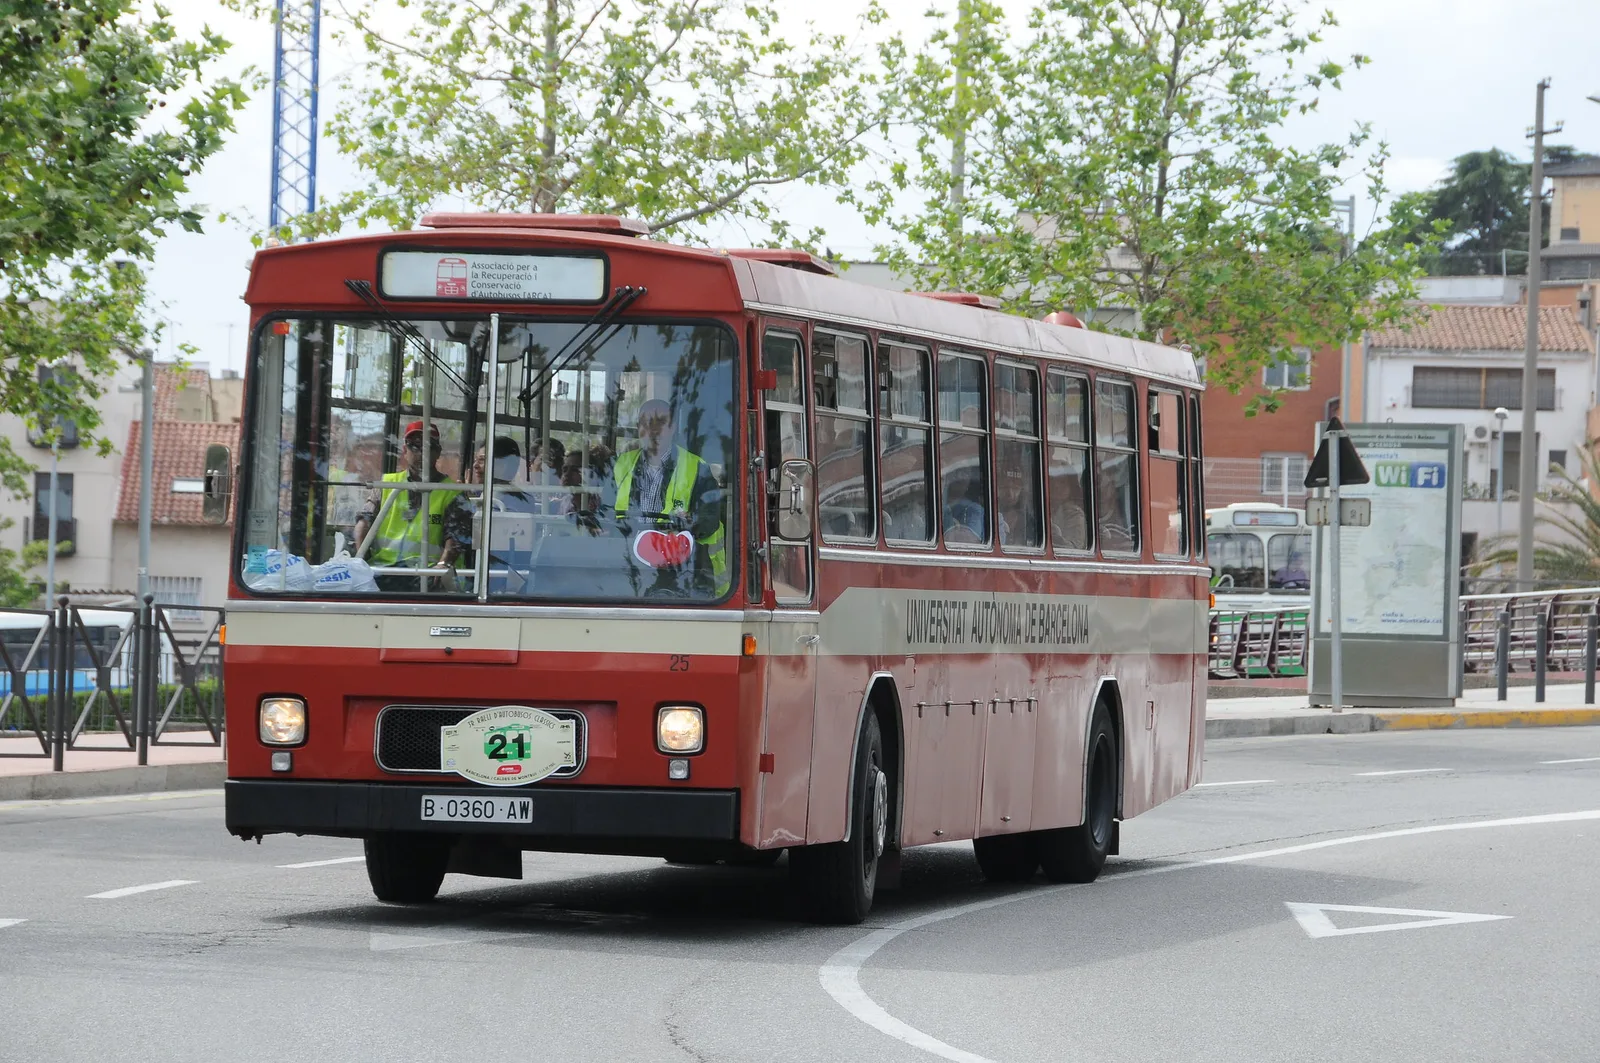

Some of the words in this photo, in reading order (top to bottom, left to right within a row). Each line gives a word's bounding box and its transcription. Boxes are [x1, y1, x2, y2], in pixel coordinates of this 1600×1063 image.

[471, 261, 514, 271] Associació
[517, 264, 529, 272] per
[471, 270, 479, 279] la
[481, 271, 532, 281] Recuperació
[471, 280, 522, 290] Conservació
[471, 290, 521, 299] d'Autobusos
[906, 598, 968, 644] UNIVERSITAT
[1024, 602, 1037, 644] DE
[1038, 602, 1089, 645] BARCELONA
[670, 654, 690, 672] 25
[494, 710, 532, 720] D'AUTOBUSOS
[488, 732, 525, 760] 21
